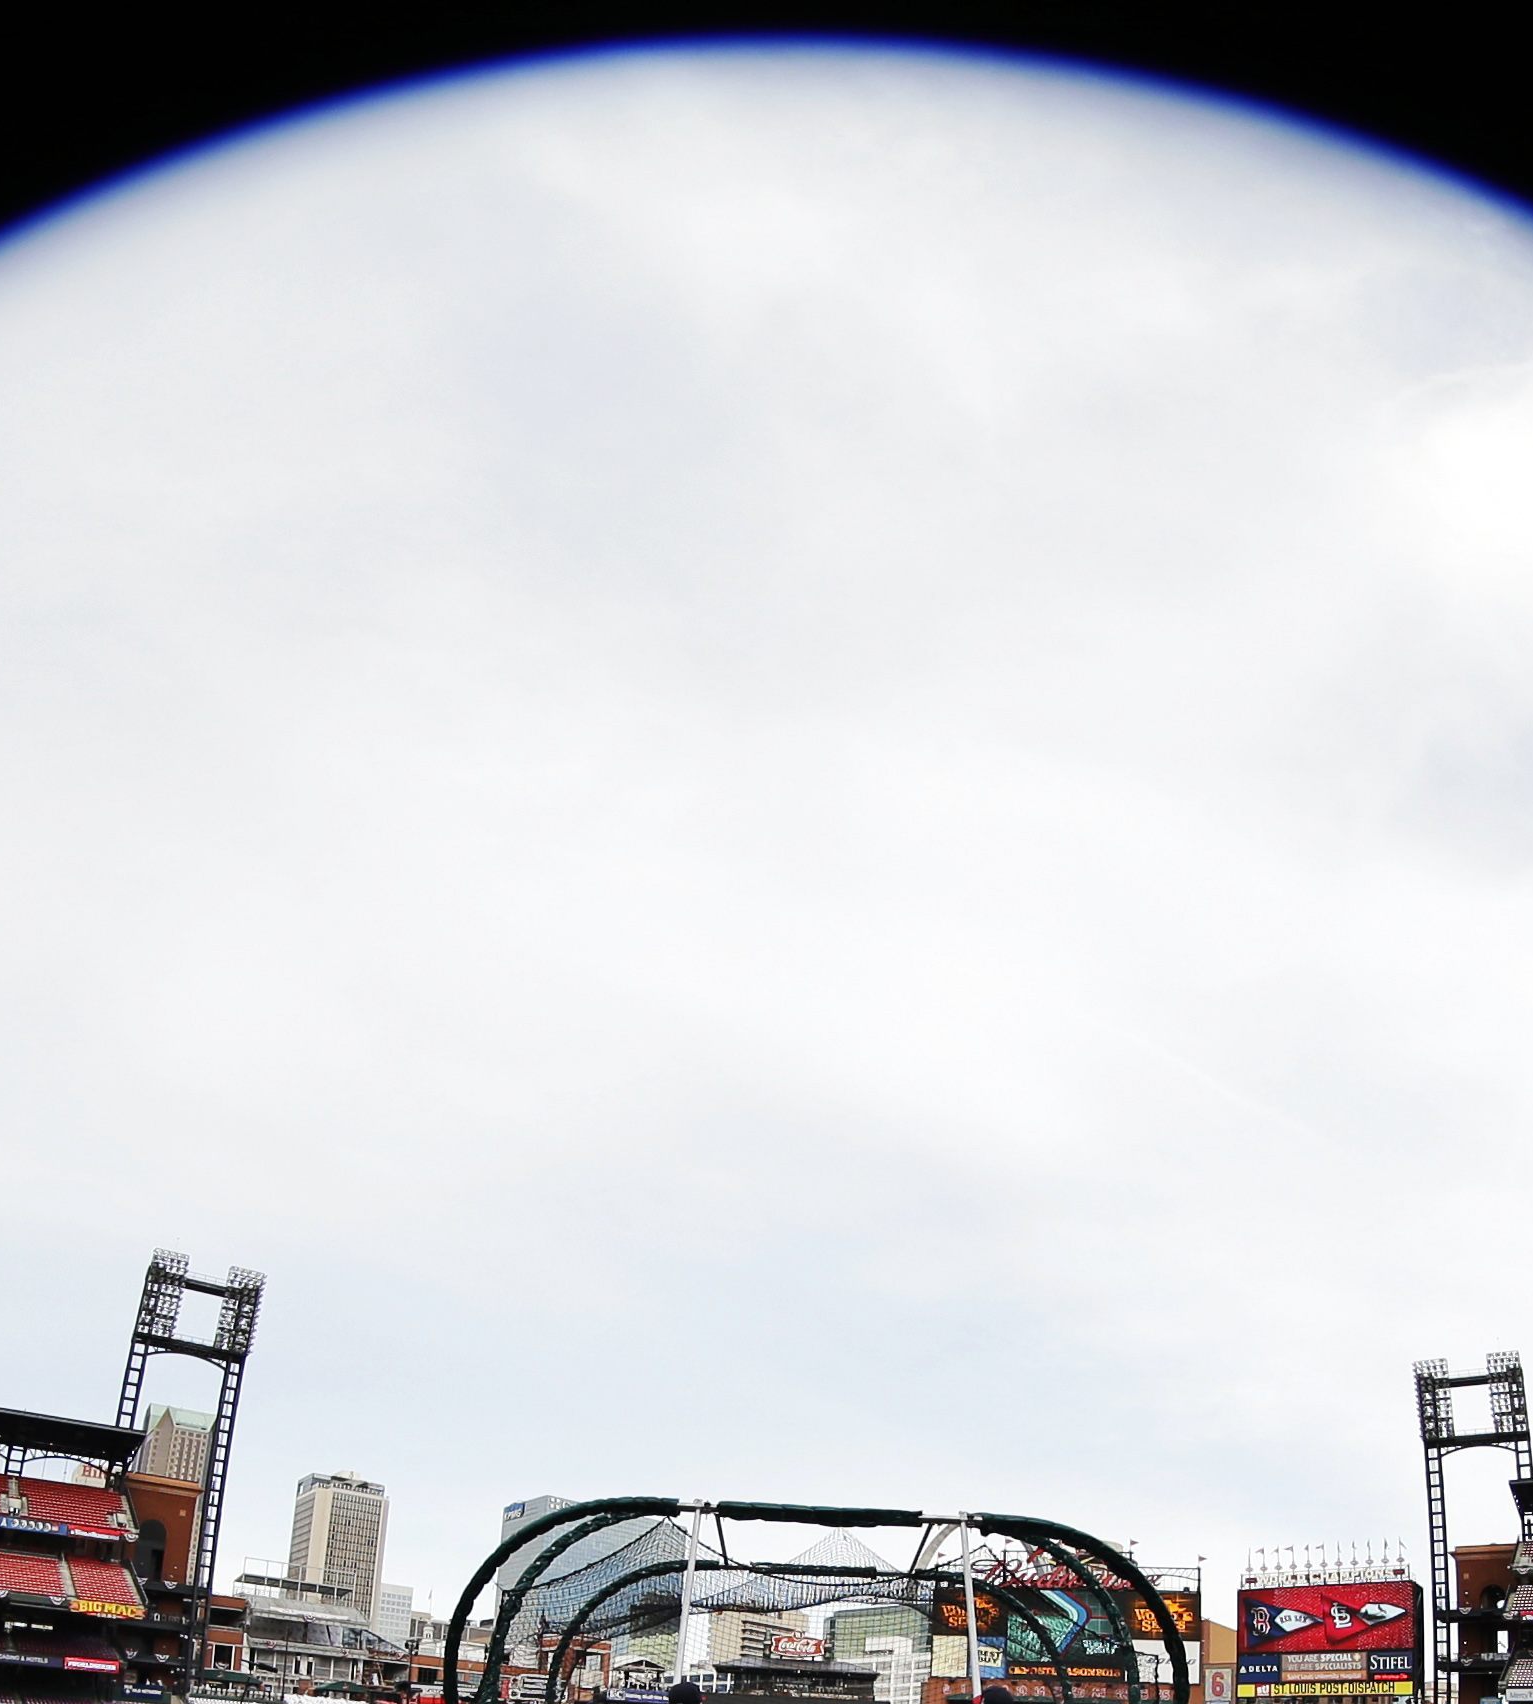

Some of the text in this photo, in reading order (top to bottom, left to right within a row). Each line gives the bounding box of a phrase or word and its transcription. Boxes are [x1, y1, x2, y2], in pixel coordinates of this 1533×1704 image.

[79, 1601, 136, 1617] BIG MAC
[1320, 1653, 1352, 1662] SPECIAL
[1370, 1655, 1412, 1670] STIFEL
[1248, 1664, 1278, 1673] DELTA
[1315, 1662, 1362, 1670] SPECIALISTS
[1212, 1672, 1225, 1697] 6
[1289, 1683, 1316, 1695] LOUIS
[1319, 1681, 1395, 1694] POST-DISPATCH
